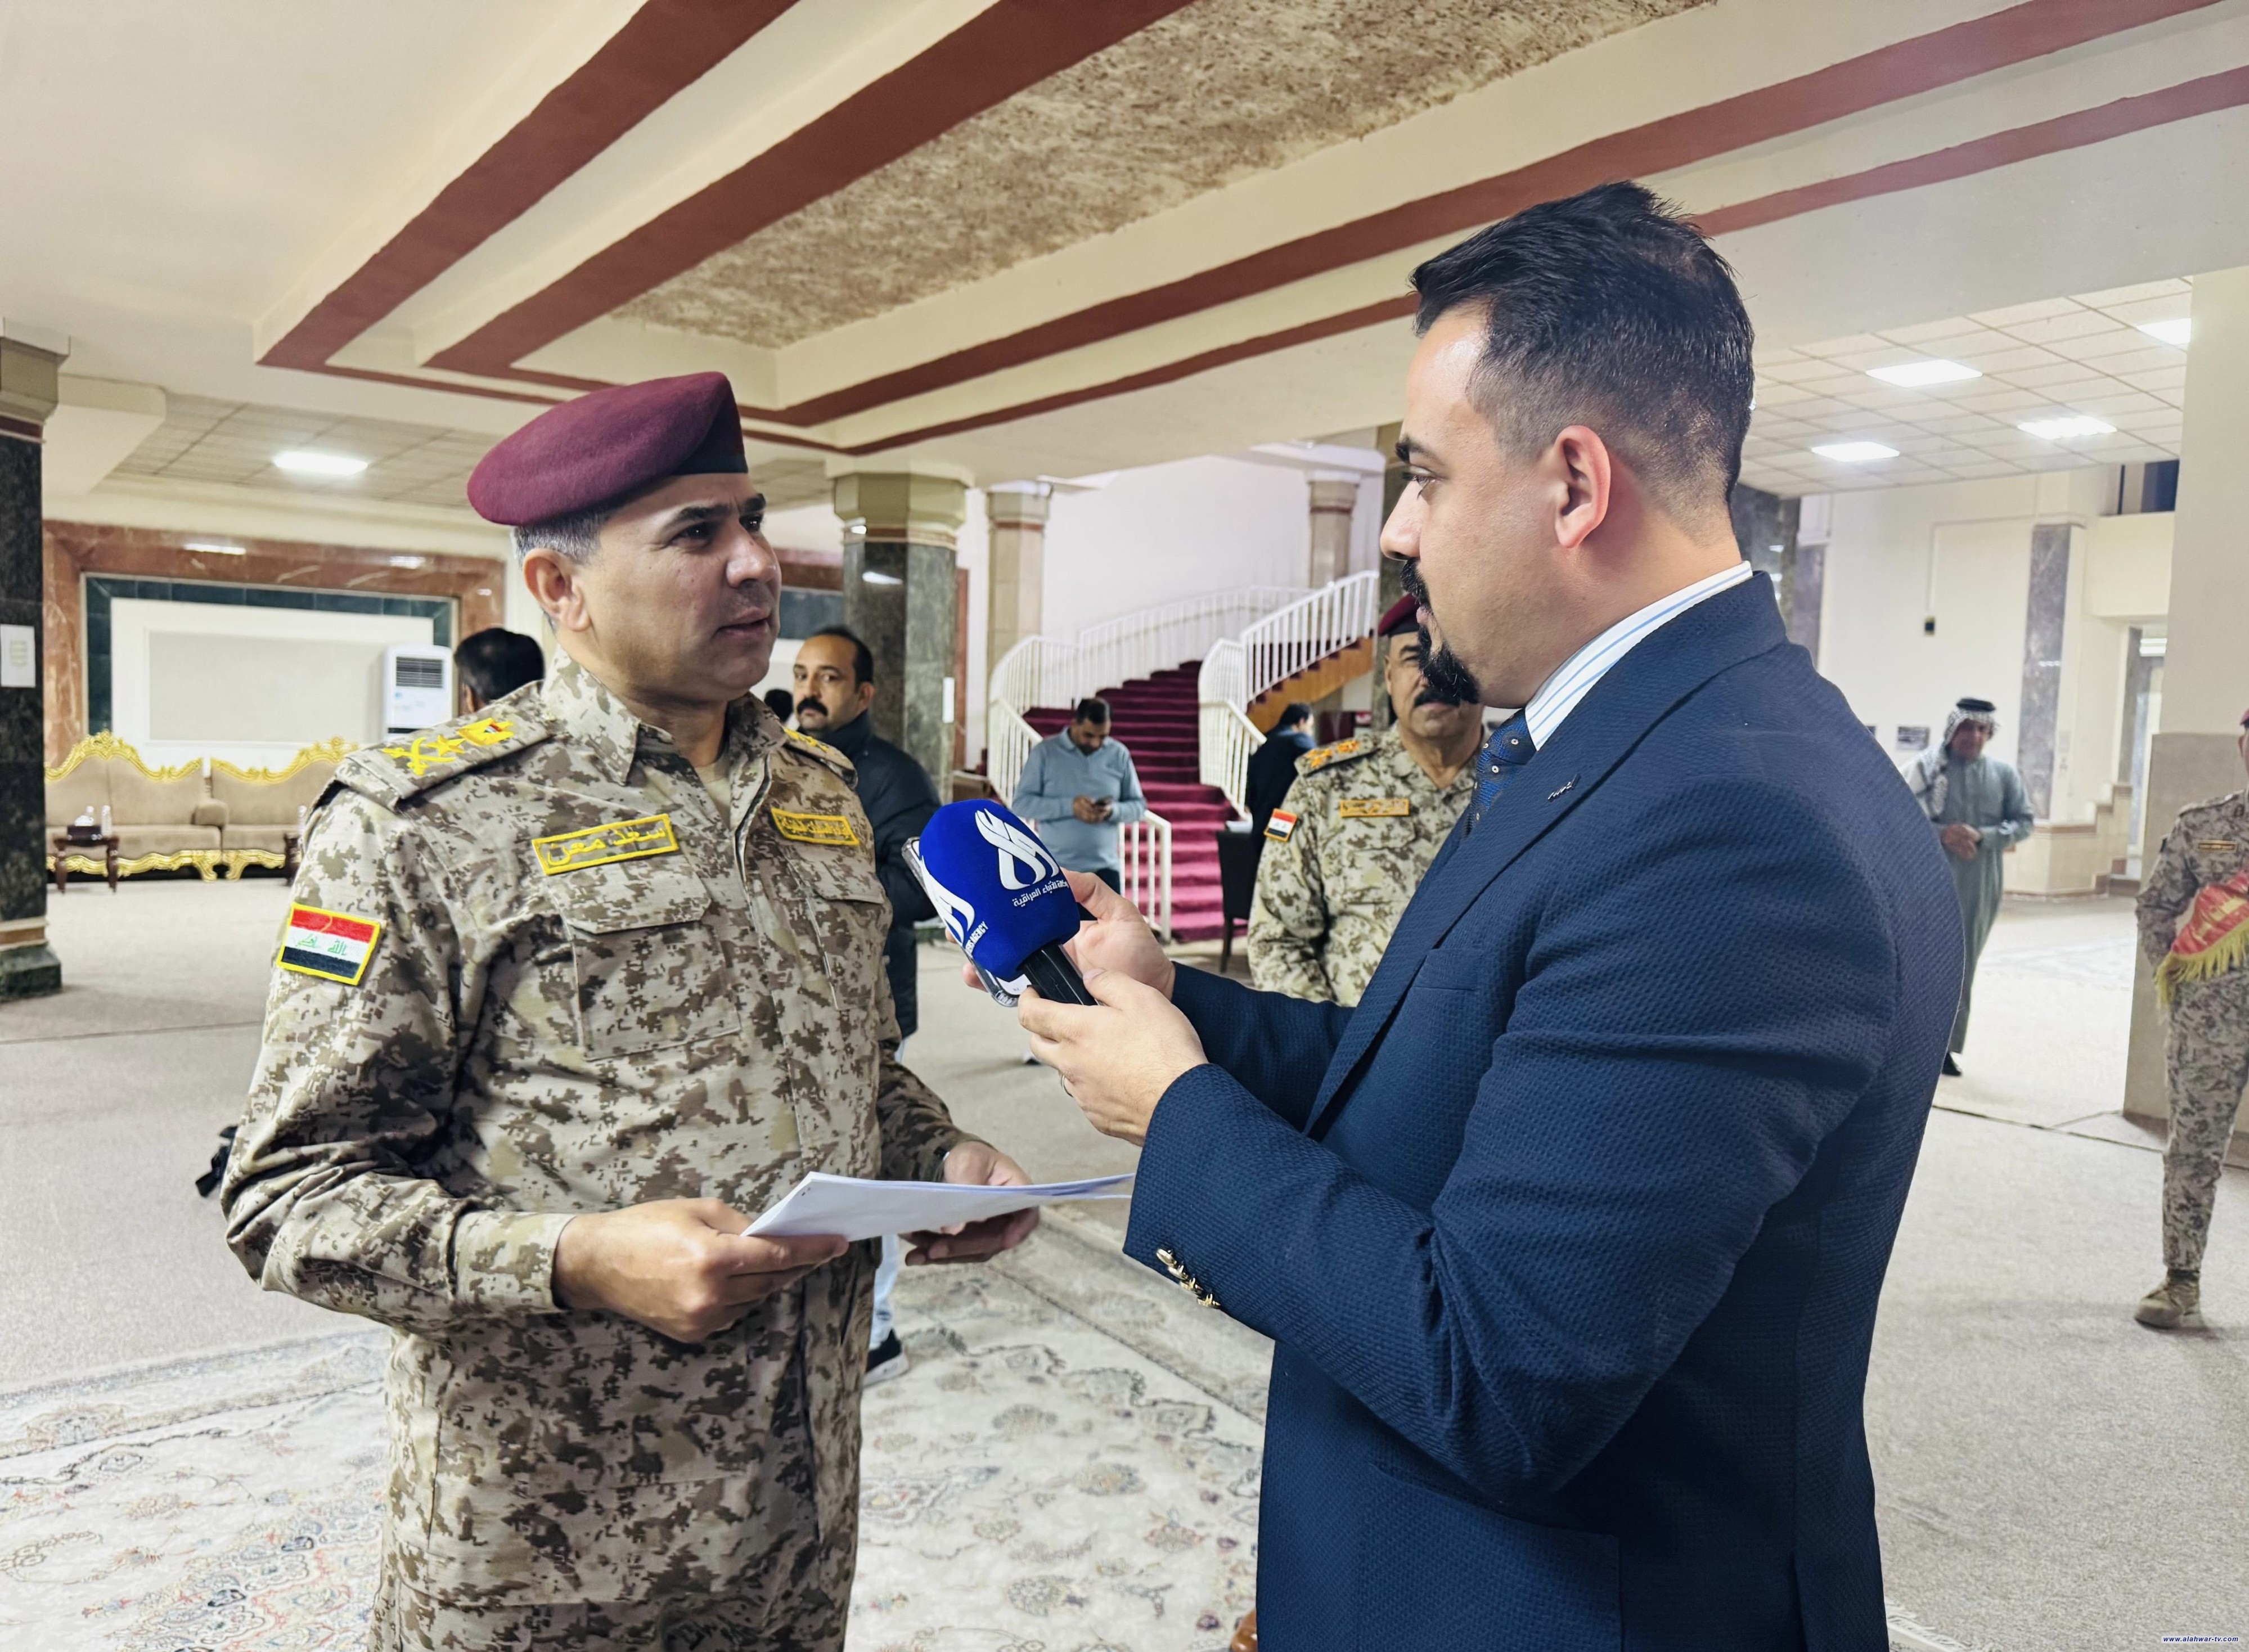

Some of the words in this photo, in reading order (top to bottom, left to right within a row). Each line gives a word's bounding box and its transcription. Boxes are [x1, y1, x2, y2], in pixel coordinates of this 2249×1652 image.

[613, 827, 666, 846] سعد
[547, 839, 606, 866] معن
[1012, 888, 1041, 907] العراقية
[969, 921, 988, 944] AGENCY
